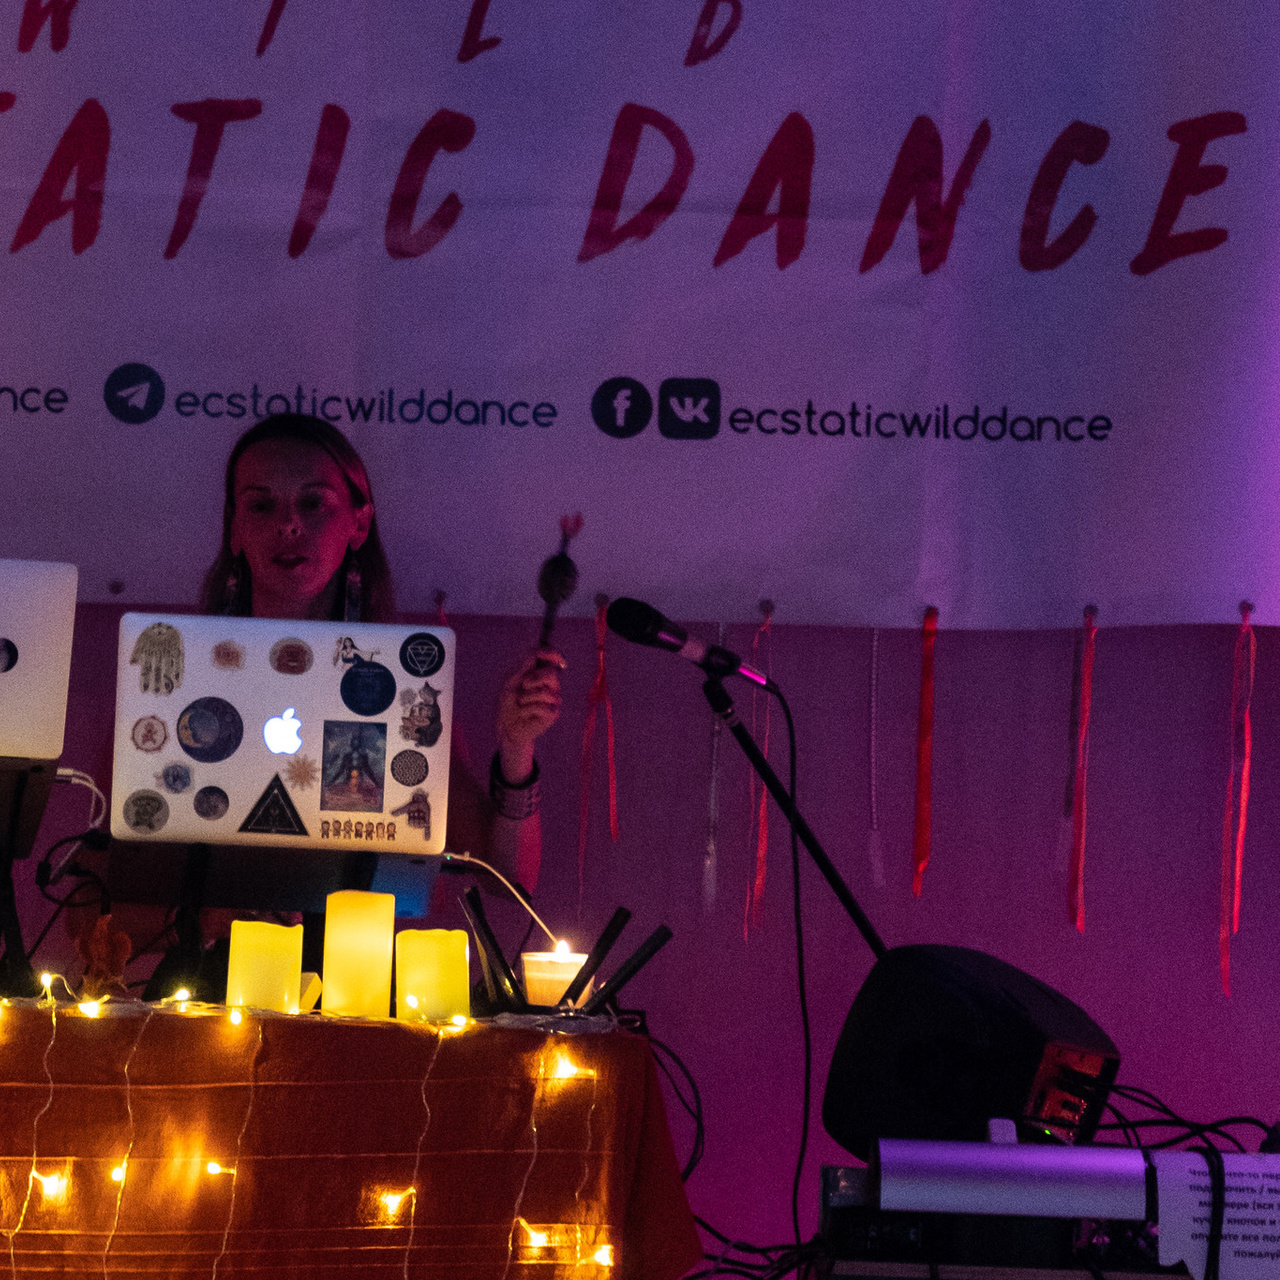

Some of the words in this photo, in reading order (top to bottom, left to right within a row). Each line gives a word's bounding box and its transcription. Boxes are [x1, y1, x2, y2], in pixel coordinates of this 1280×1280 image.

[577, 102, 1248, 277] DANCE
[174, 384, 558, 427] ecstaticwilddance
[727, 399, 1113, 443] ecstaticwilddance
